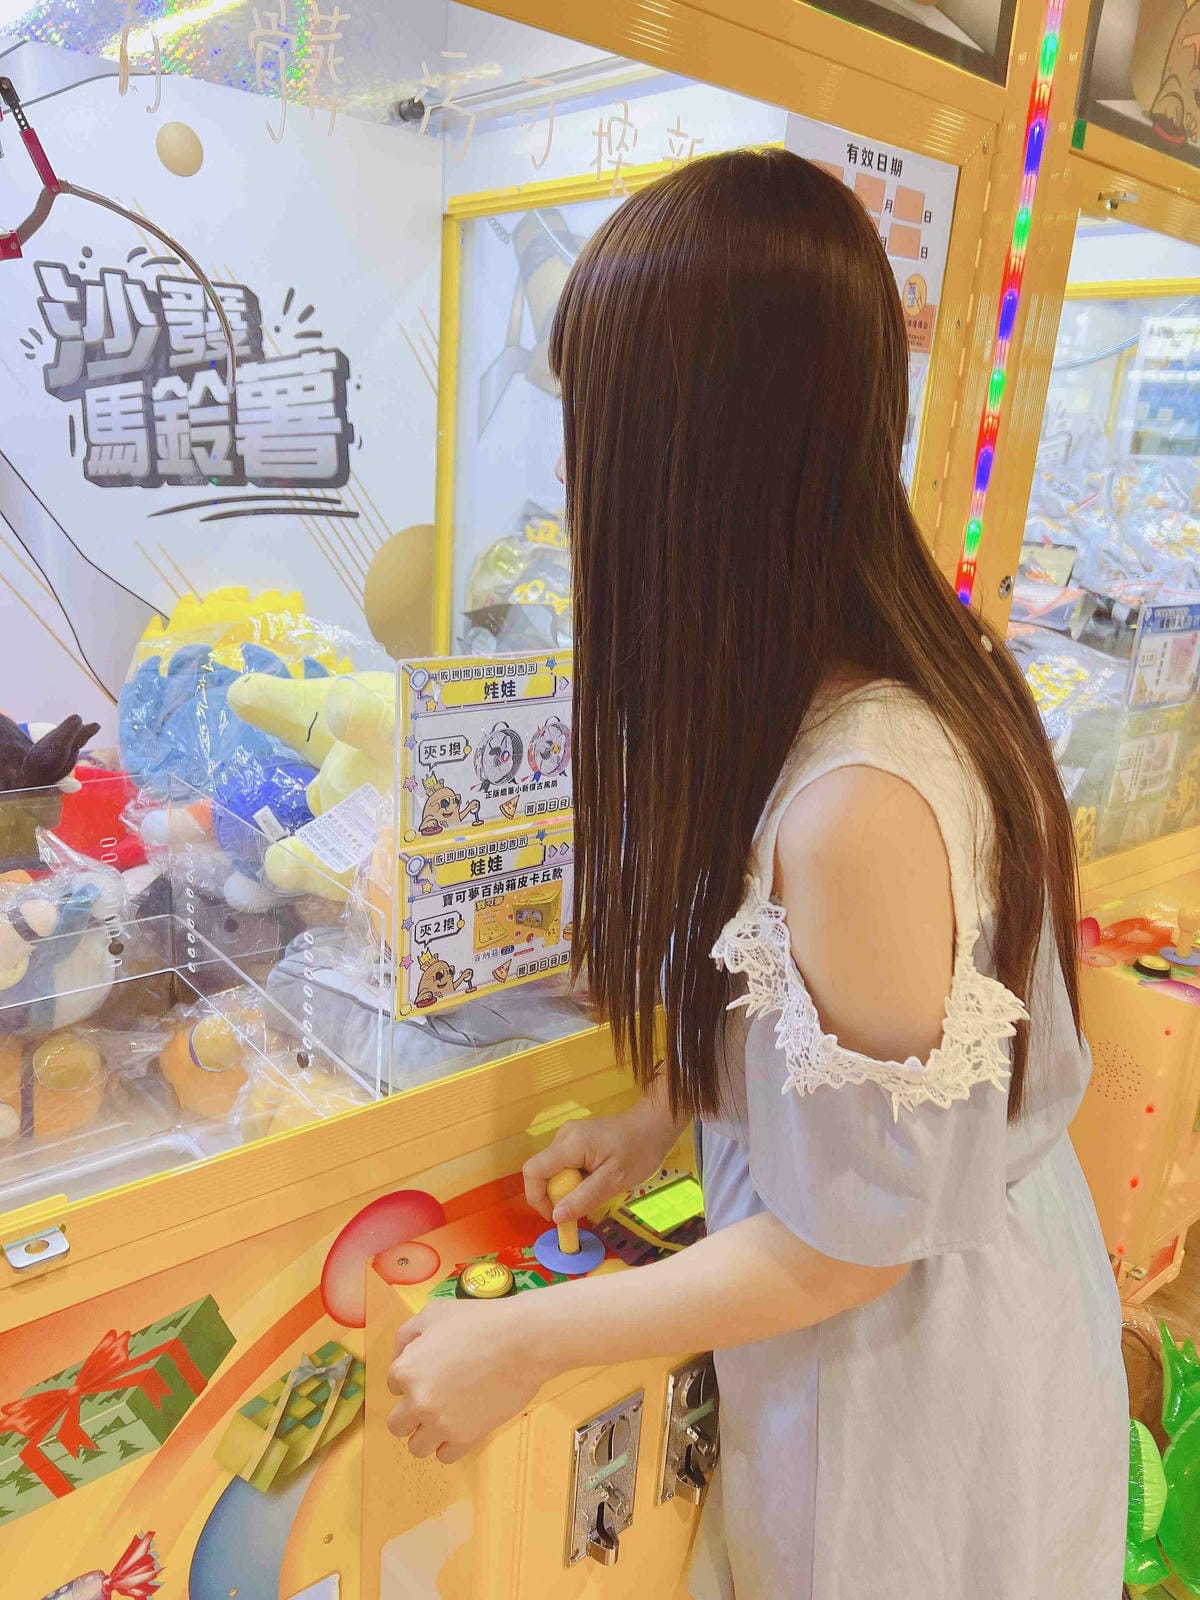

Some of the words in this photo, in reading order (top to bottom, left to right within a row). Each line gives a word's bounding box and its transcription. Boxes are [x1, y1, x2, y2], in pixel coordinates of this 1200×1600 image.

[846, 143, 903, 177] 有效日期
[884, 198, 893, 213] 月
[924, 211, 932, 224] 日
[920, 246, 928, 259] 日
[84, 349, 350, 486] 馬鈴薯
[484, 680, 516, 700] 娃娃
[423, 740, 462, 760] 夾5換
[525, 797, 573, 816] 限當日兌
[470, 855, 503, 878] 娃娃
[442, 867, 563, 907] 寶可夢百納箱皮卡丘款
[419, 918, 456, 938] 夾2換
[466, 1264, 505, 1290] 取物
